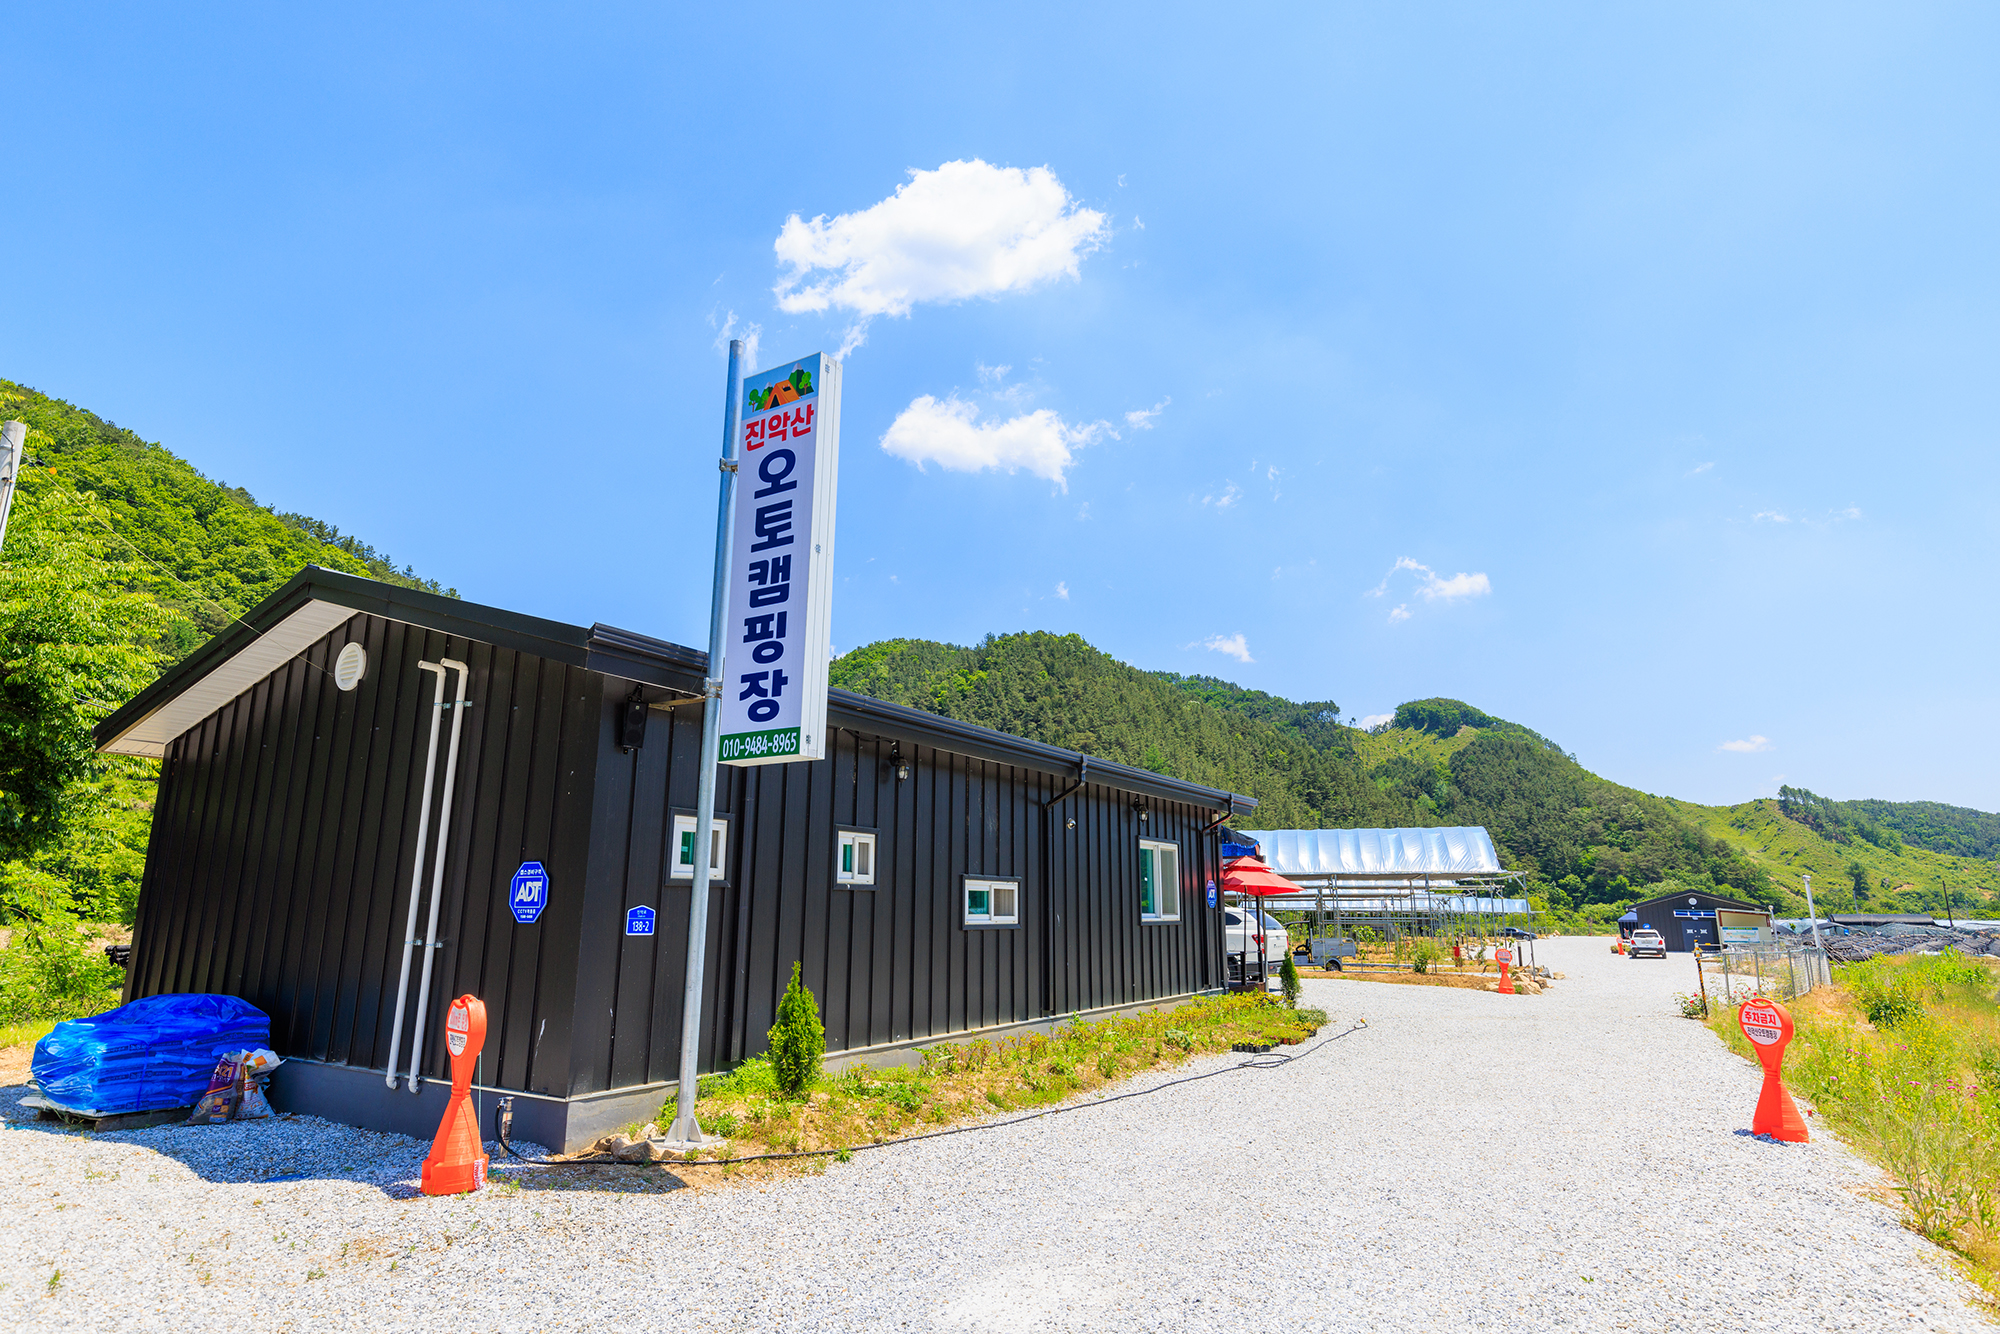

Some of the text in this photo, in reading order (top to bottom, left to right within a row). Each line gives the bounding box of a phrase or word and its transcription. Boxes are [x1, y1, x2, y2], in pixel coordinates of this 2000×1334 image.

[745, 403, 814, 452] 진악산
[739, 448, 798, 723] 오토캠핑장
[722, 735, 797, 759] 010-9484-8965
[515, 881, 543, 903] ADT
[632, 920, 650, 932] 138-2
[1744, 1010, 1777, 1026] 주차금지
